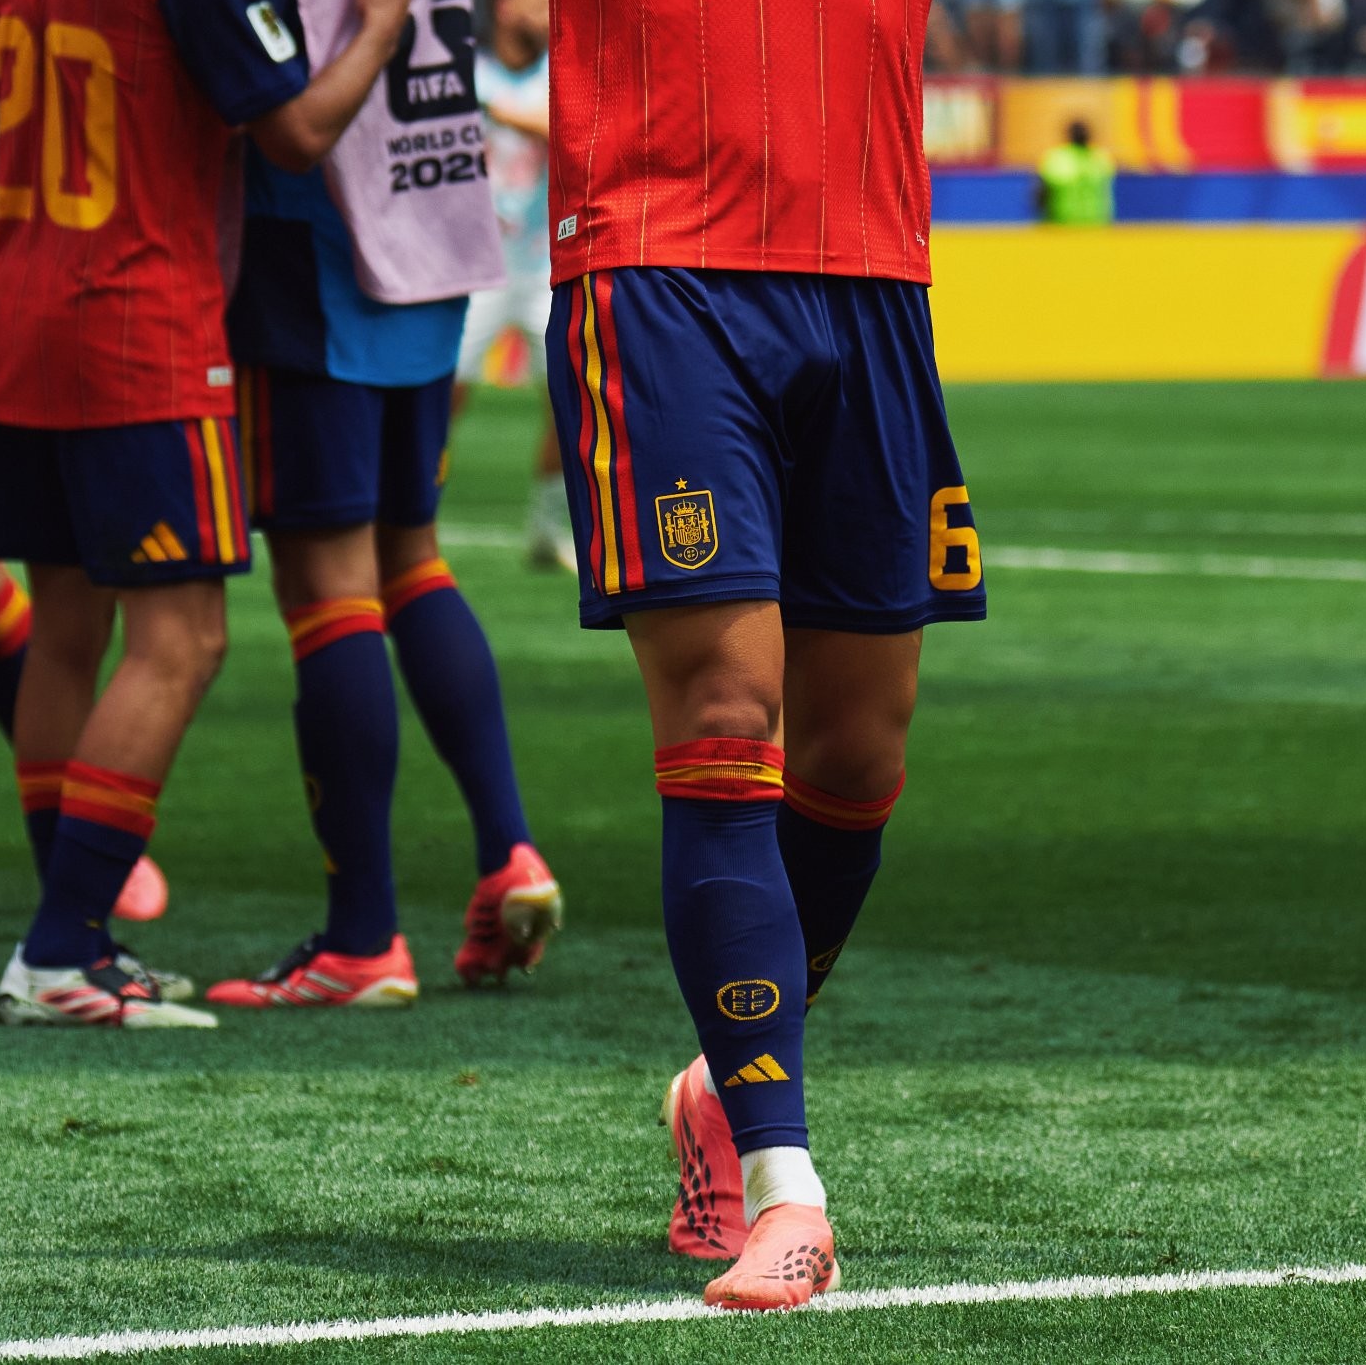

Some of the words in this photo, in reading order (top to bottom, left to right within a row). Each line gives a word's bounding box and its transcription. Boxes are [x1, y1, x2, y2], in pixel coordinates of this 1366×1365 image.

[407, 70, 465, 106] FIFA
[387, 131, 454, 155] WORLD
[929, 485, 982, 591] 6
